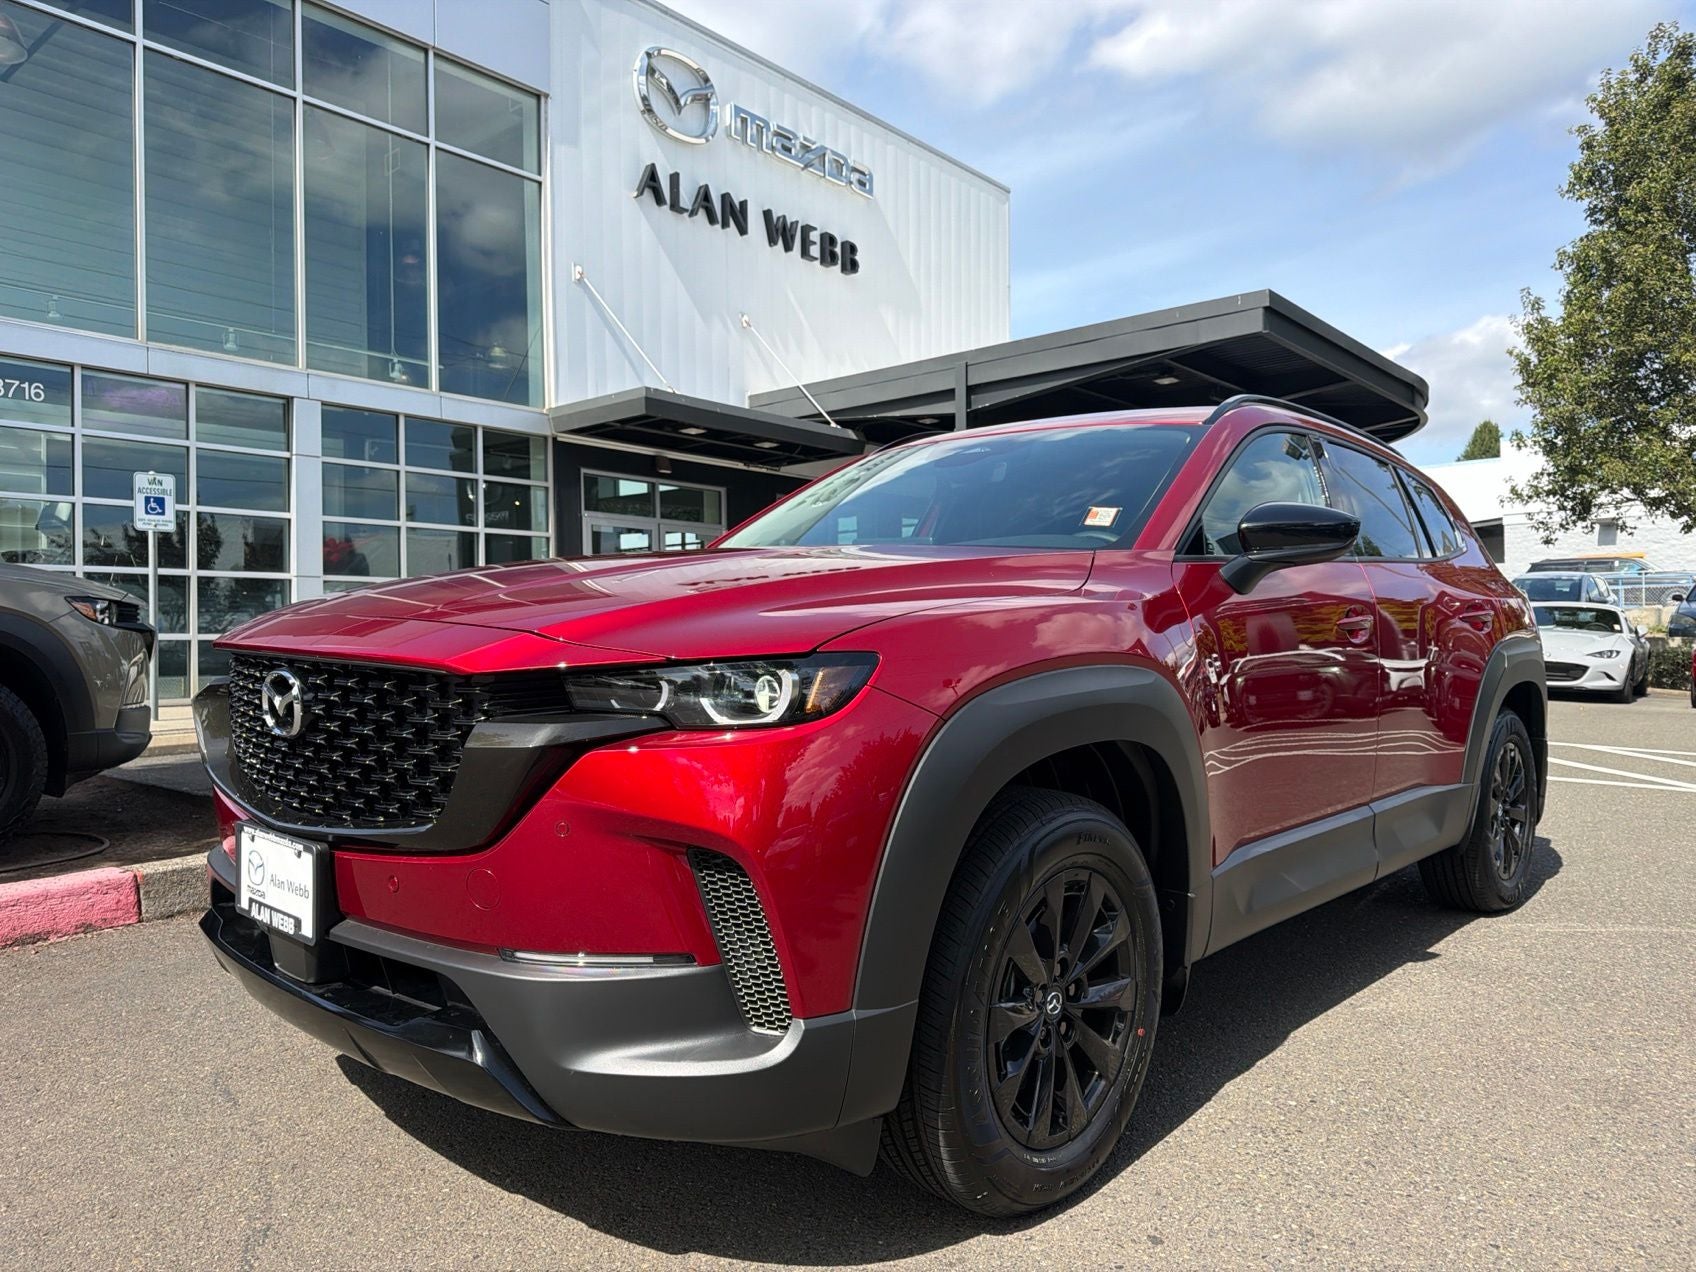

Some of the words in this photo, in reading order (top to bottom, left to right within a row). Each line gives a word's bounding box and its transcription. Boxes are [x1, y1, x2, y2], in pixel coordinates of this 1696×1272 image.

[725, 101, 874, 199] mazda
[633, 162, 748, 236] ALAN
[762, 208, 859, 275] WEBB
[137, 486, 172, 497] ACCESSIBLE
[147, 476, 163, 487] VAN
[269, 873, 286, 891] Alan
[286, 879, 310, 900] Webb
[250, 901, 271, 925] ALAN
[271, 909, 296, 935] WEBB
